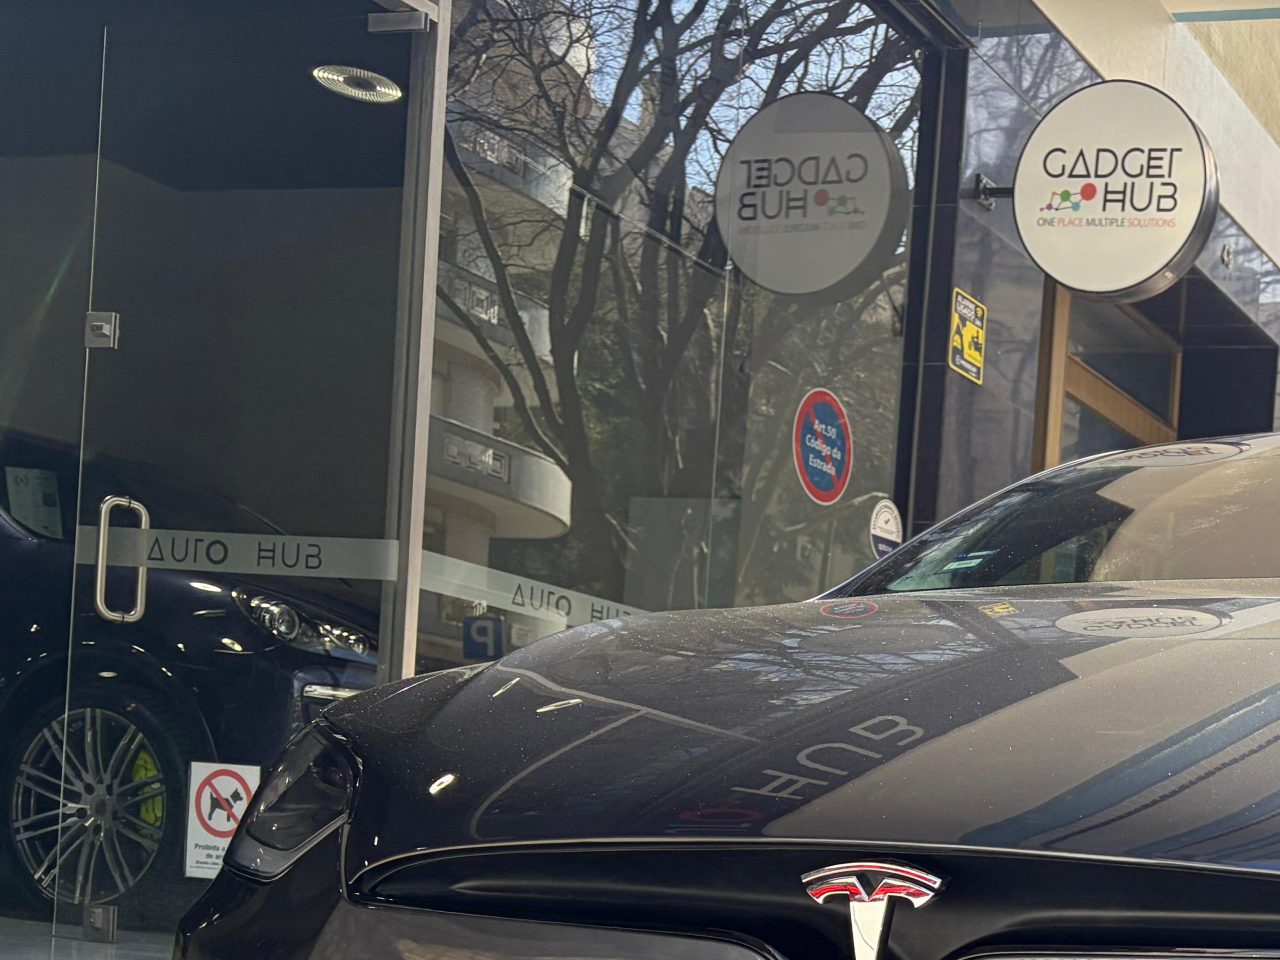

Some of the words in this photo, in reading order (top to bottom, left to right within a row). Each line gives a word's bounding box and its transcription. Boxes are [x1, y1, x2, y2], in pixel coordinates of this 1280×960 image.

[1042, 147, 1184, 179] GADGET
[1102, 181, 1179, 213] HUB
[1036, 217, 1056, 228] ONE
[1057, 217, 1084, 228] PLACE
[1085, 217, 1127, 228] MULTIPLE
[1128, 218, 1176, 229] SOLUTIONS
[805, 434, 831, 456] Código
[831, 446, 842, 460] da
[808, 454, 836, 476] Estrada
[147, 537, 229, 566] AUTO
[256, 541, 322, 570] HUB
[511, 583, 573, 617] AUTO
